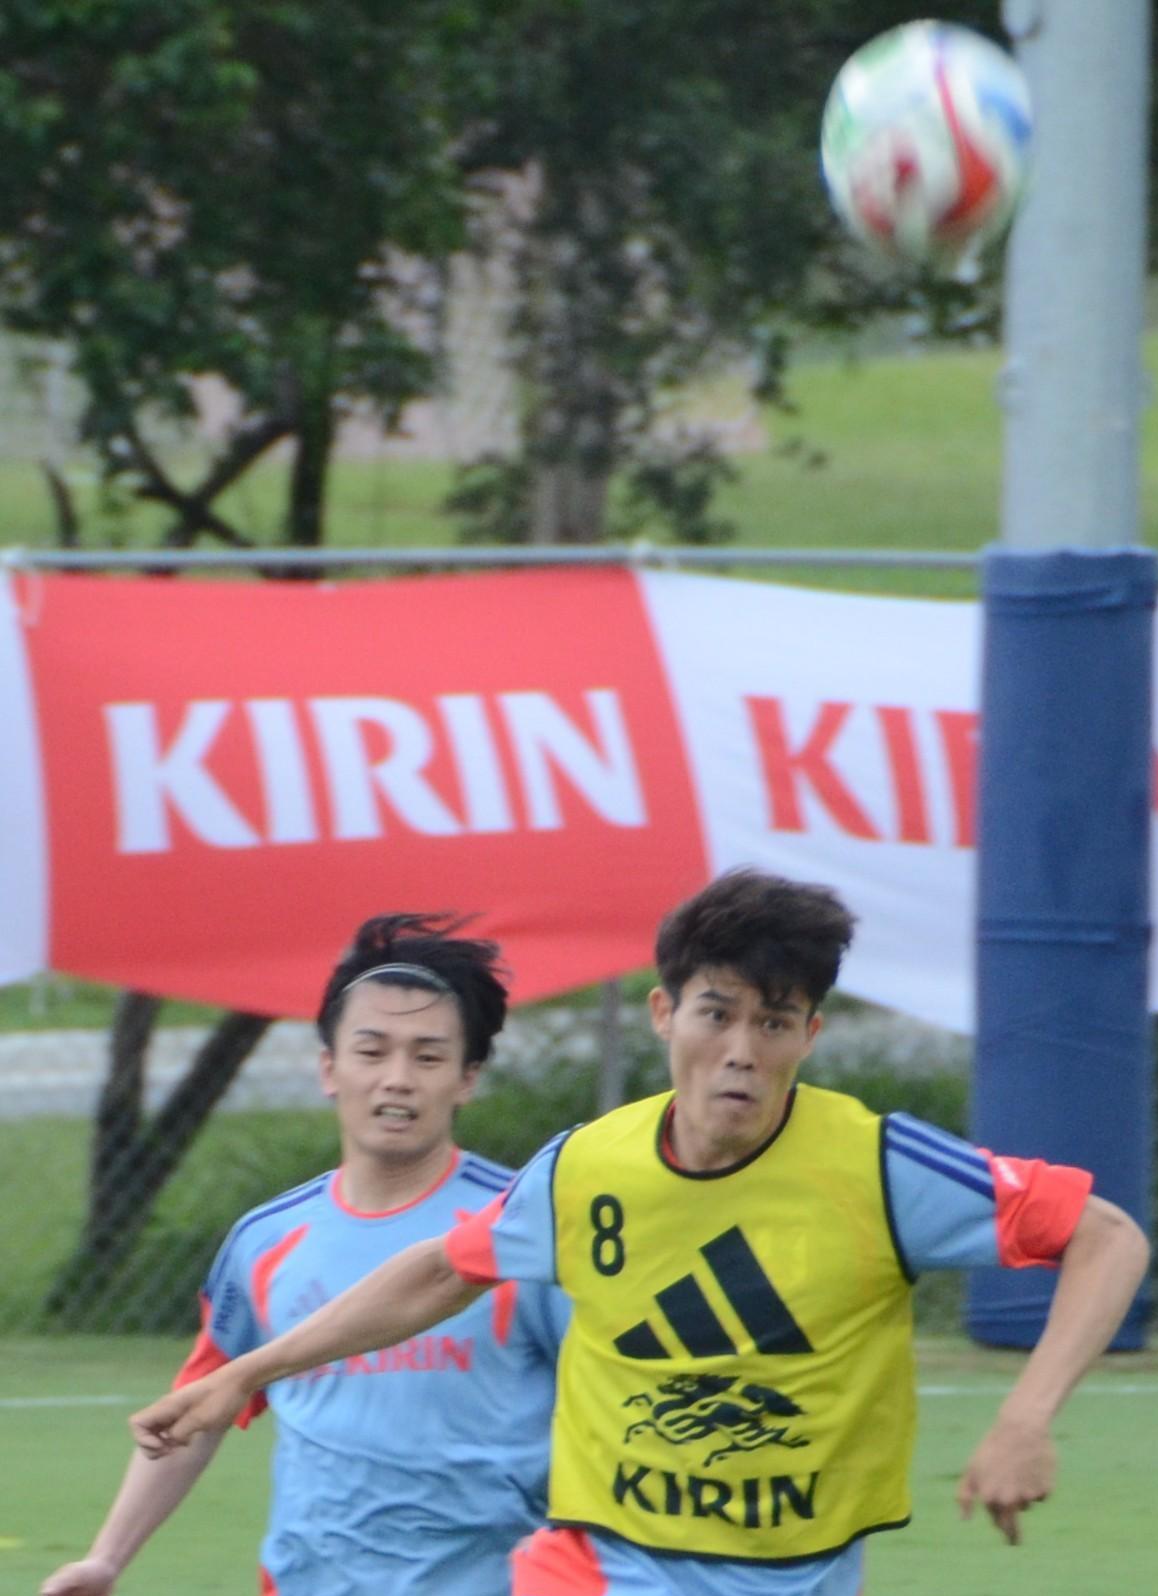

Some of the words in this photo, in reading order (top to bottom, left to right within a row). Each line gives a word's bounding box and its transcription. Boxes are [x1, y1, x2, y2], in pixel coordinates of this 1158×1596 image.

[104, 689, 649, 855] KIRIN
[590, 1193, 626, 1277] 8
[611, 1460, 820, 1529] KIRIN
